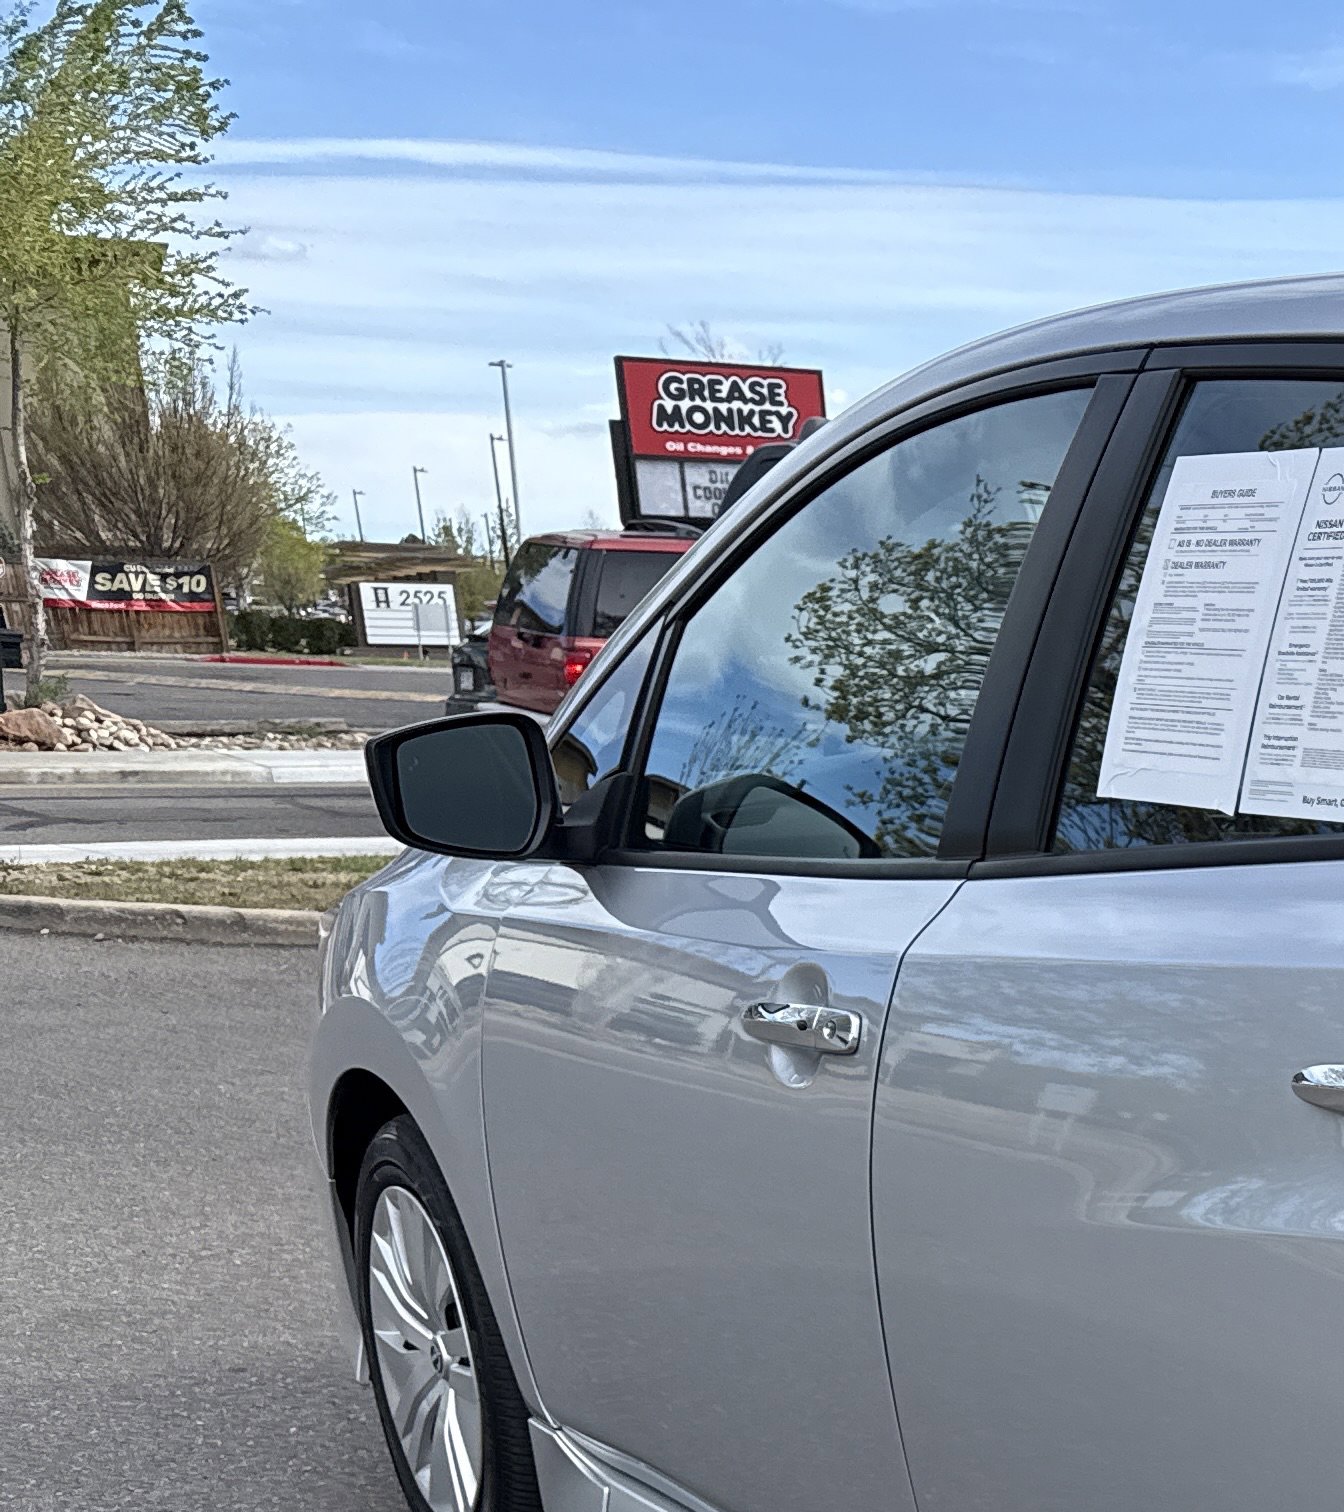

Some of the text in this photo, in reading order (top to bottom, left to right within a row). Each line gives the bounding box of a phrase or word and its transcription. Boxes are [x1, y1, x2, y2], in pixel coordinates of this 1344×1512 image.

[660, 373, 786, 408] GREASE
[654, 402, 795, 437] MONKEY
[665, 440, 684, 452] Oil
[687, 441, 743, 456] Changes
[1210, 487, 1258, 499] BUYERS GUIDE
[1315, 518, 1344, 530] NISSAN
[94, 572, 162, 592] SAVE
[165, 574, 208, 594] $10
[399, 589, 448, 606] 2525
[1302, 795, 1315, 807] Buy
[1316, 795, 1339, 808] Smart,
